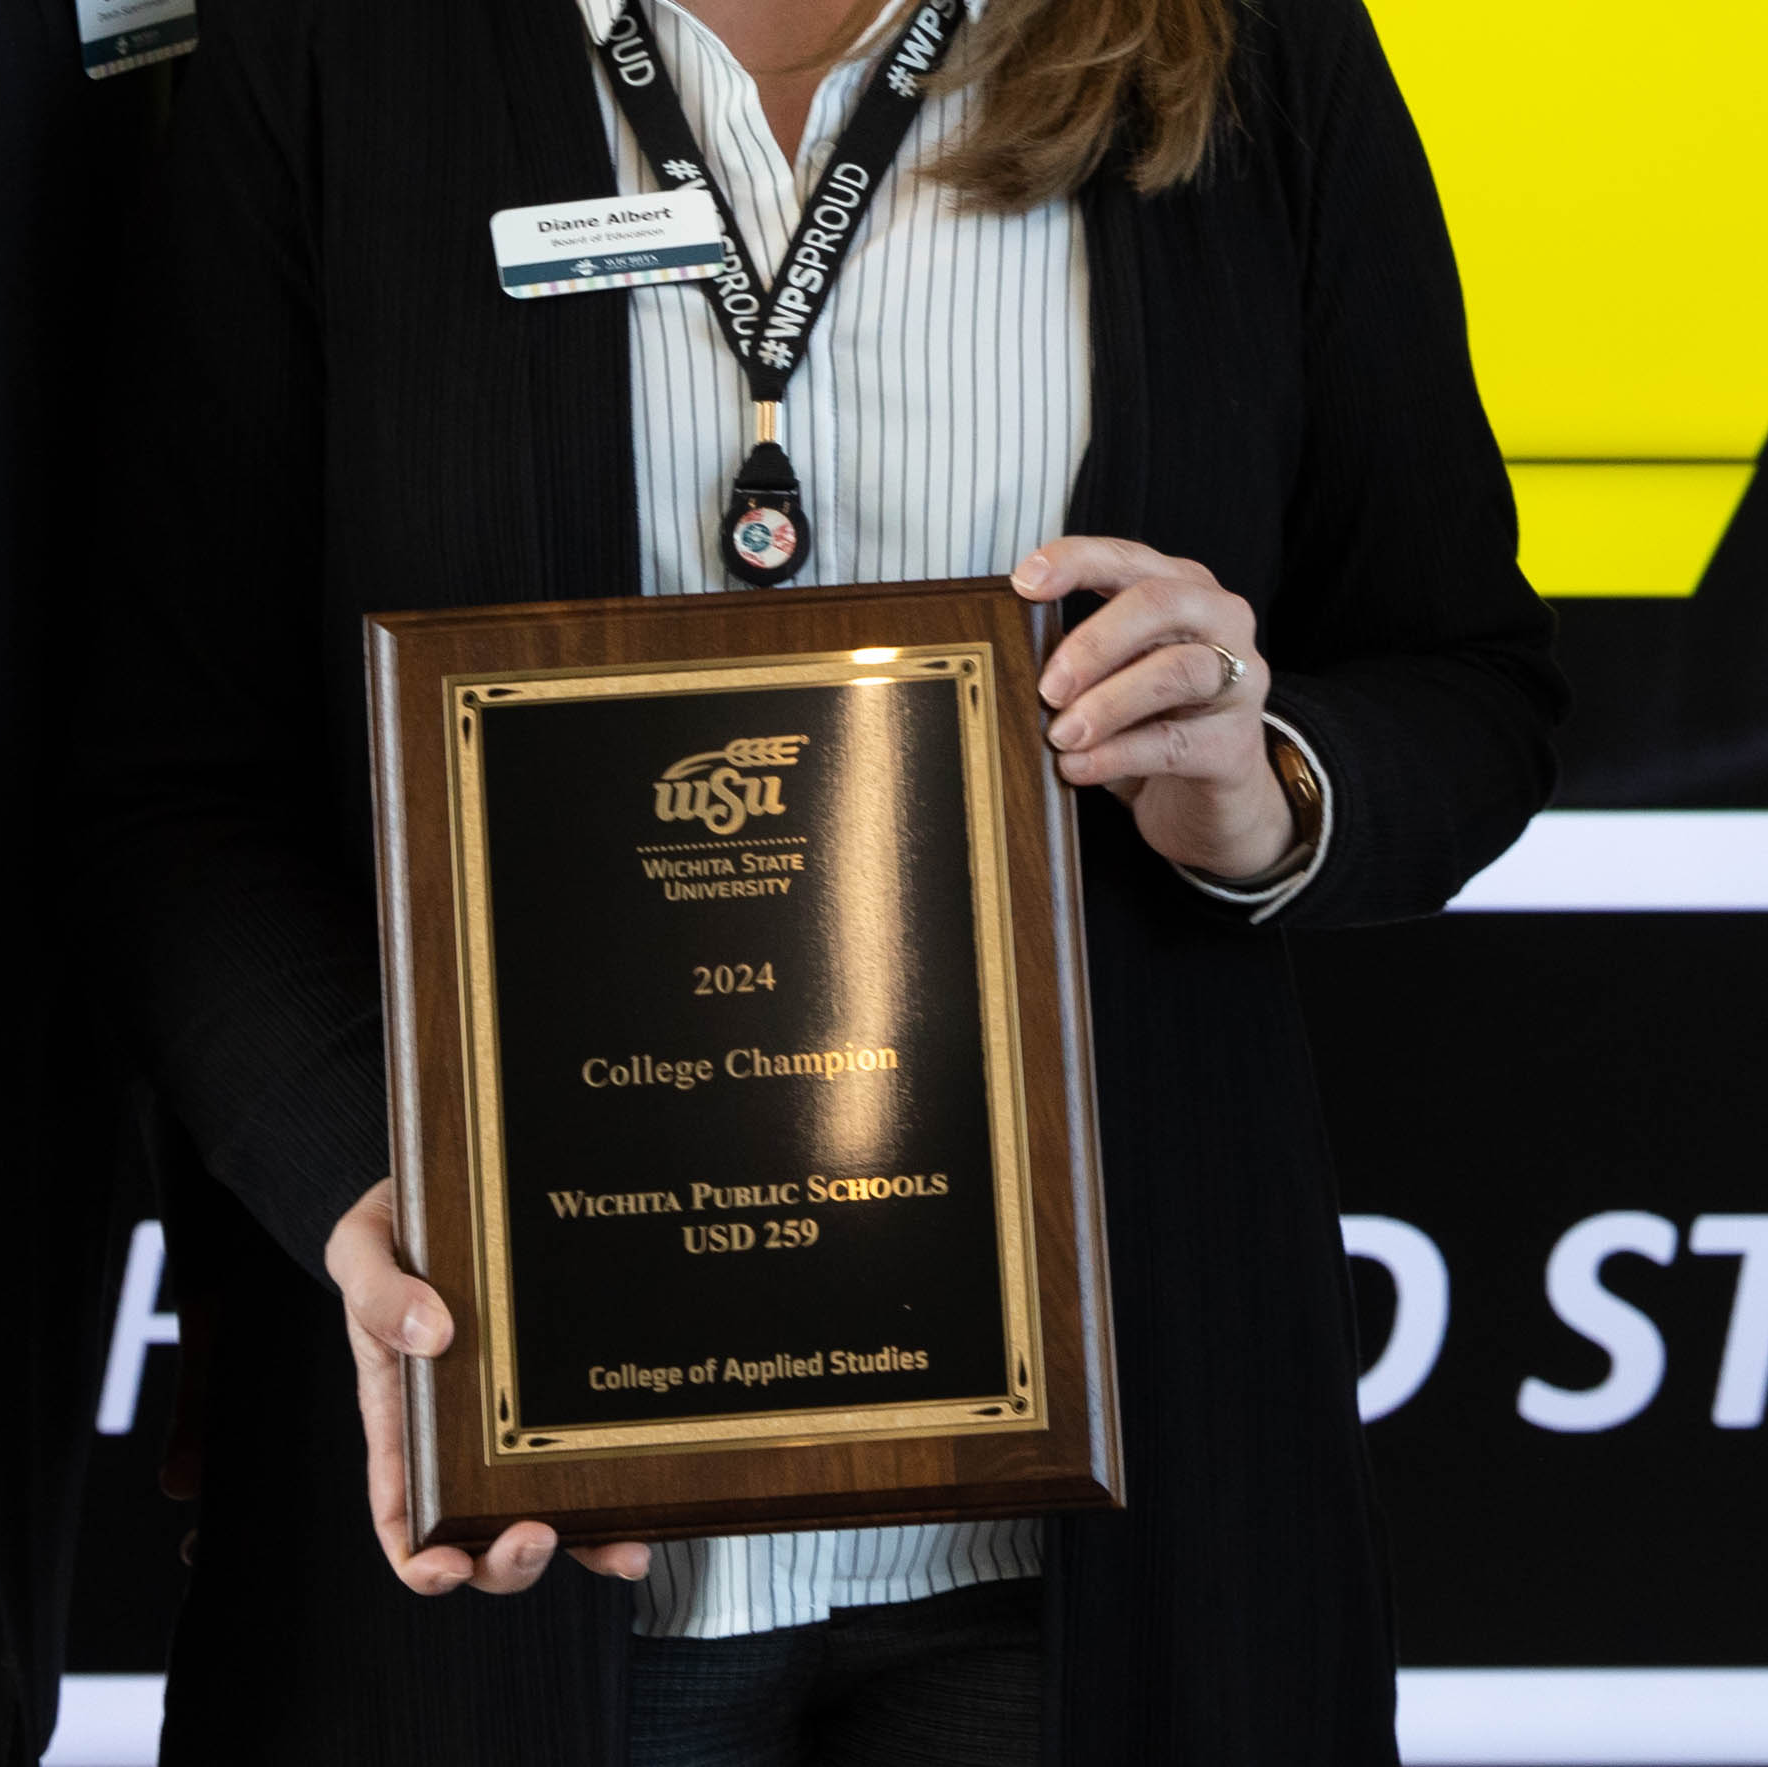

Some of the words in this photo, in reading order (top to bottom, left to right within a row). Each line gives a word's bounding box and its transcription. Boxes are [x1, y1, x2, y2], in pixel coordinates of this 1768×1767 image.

[537, 216, 601, 233] Diane
[606, 206, 674, 226] Albert
[757, 162, 870, 370] #WPSPROUD
[641, 857, 736, 880] WICHITA
[740, 852, 806, 874] STATE
[663, 877, 793, 901] UNIVERSITY
[692, 961, 776, 996] 2024
[581, 1055, 713, 1090] College
[724, 1041, 899, 1080] Champion
[547, 1189, 682, 1219] WICHITA
[690, 1181, 800, 1211] PUBLIC
[807, 1173, 950, 1203] SCHOOLS
[682, 1222, 756, 1254] USD
[763, 1218, 820, 1249] 259
[588, 1364, 683, 1393] College
[688, 1357, 718, 1385] of
[723, 1352, 825, 1387] Applied
[829, 1345, 930, 1376] Studies
